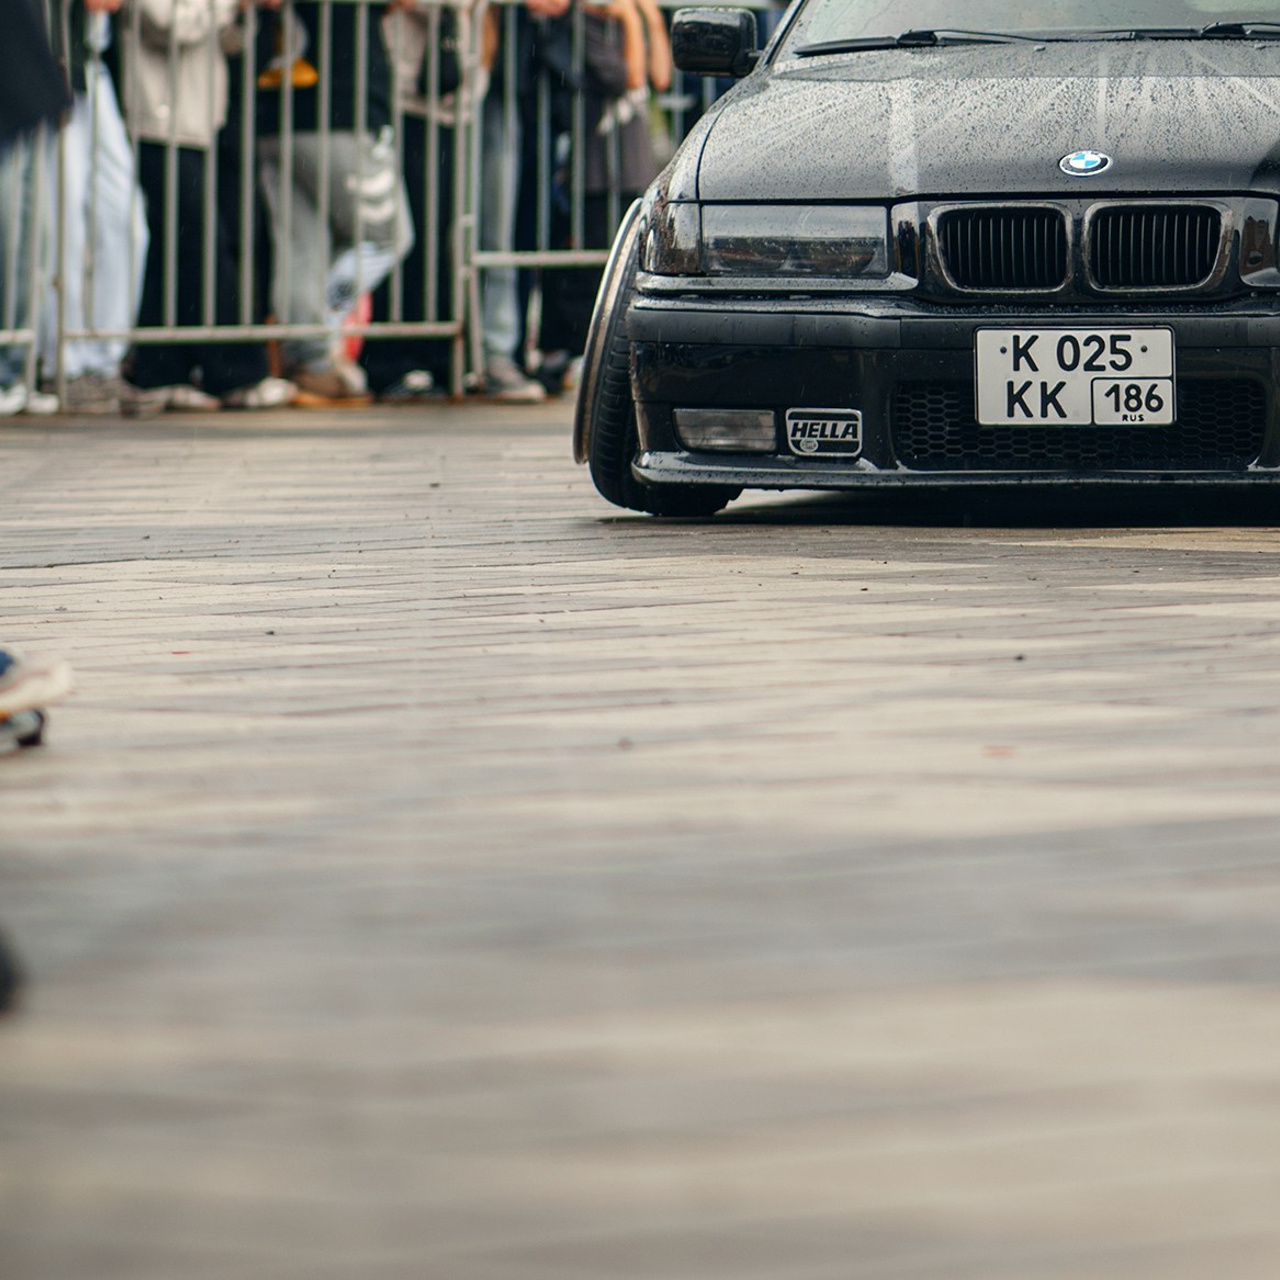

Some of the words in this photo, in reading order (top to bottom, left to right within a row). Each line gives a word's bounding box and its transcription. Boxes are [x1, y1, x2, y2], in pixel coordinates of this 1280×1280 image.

[1012, 334, 1039, 372] K
[1056, 334, 1133, 372] 025
[1006, 380, 1068, 419] KK
[1104, 383, 1164, 413] 186
[790, 422, 858, 439] HELLA
[1121, 414, 1145, 422] RUS
